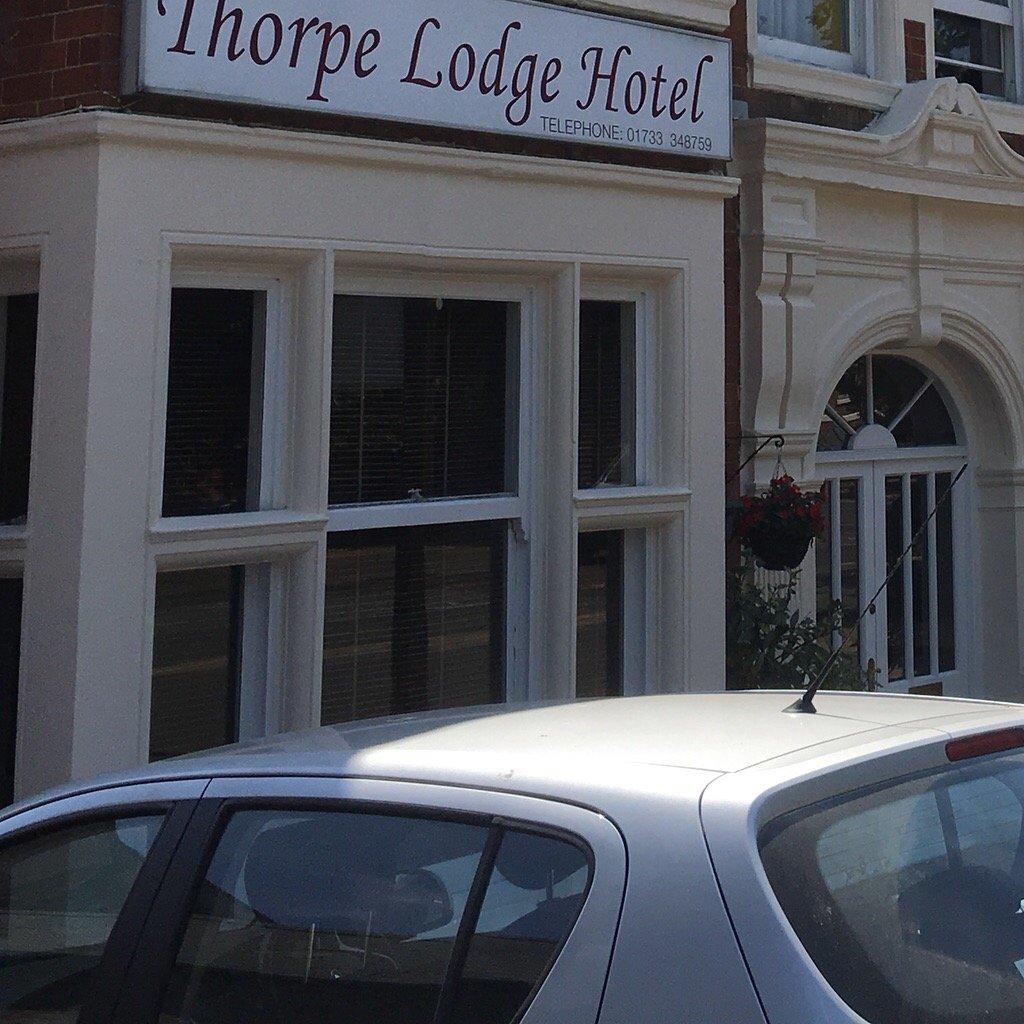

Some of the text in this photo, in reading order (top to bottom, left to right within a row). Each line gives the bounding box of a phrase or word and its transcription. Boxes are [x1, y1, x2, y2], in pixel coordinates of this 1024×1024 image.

[400, 17, 562, 125] Lodge
[576, 45, 713, 123] Hotel
[540, 116, 712, 152] TELEPHONE: 01733 348759
